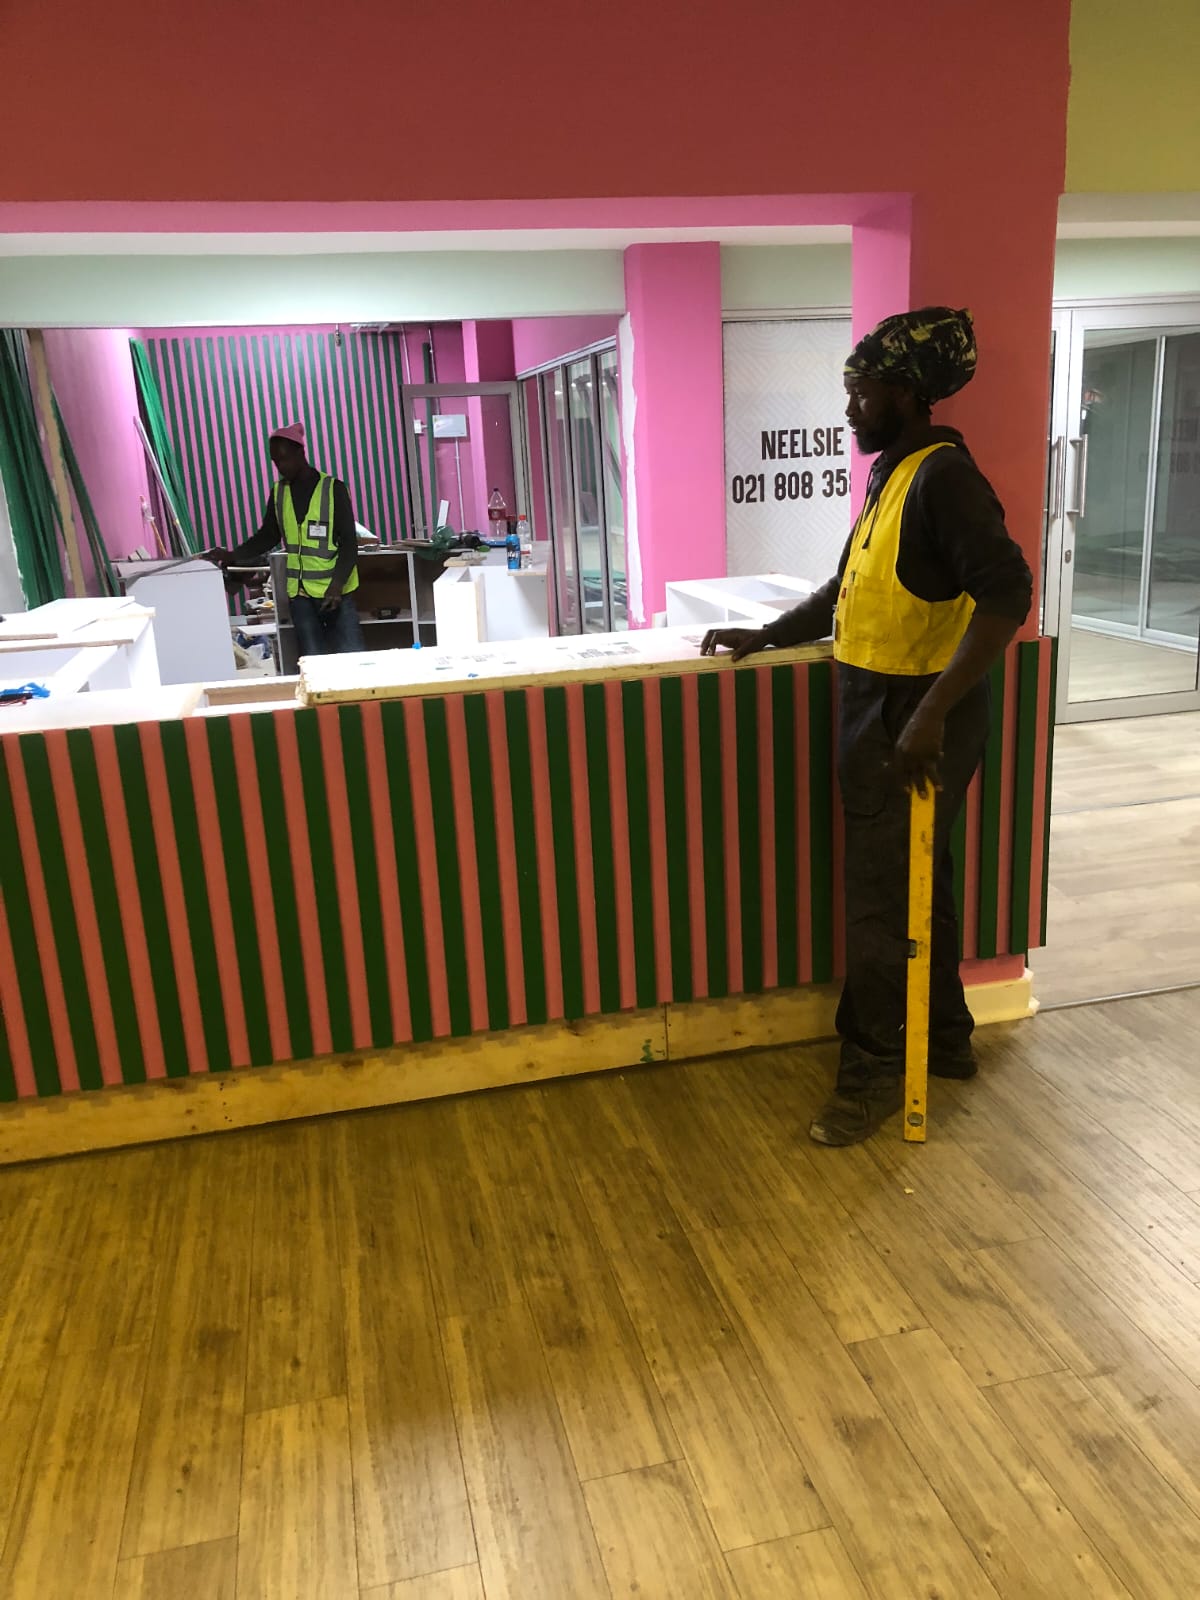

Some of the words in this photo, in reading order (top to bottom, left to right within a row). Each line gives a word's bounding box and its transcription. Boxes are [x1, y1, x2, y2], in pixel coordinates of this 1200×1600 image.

[761, 427, 844, 460] NEELSIE
[732, 474, 765, 503] 021
[774, 471, 813, 501] 808
[822, 468, 851, 498] 35
